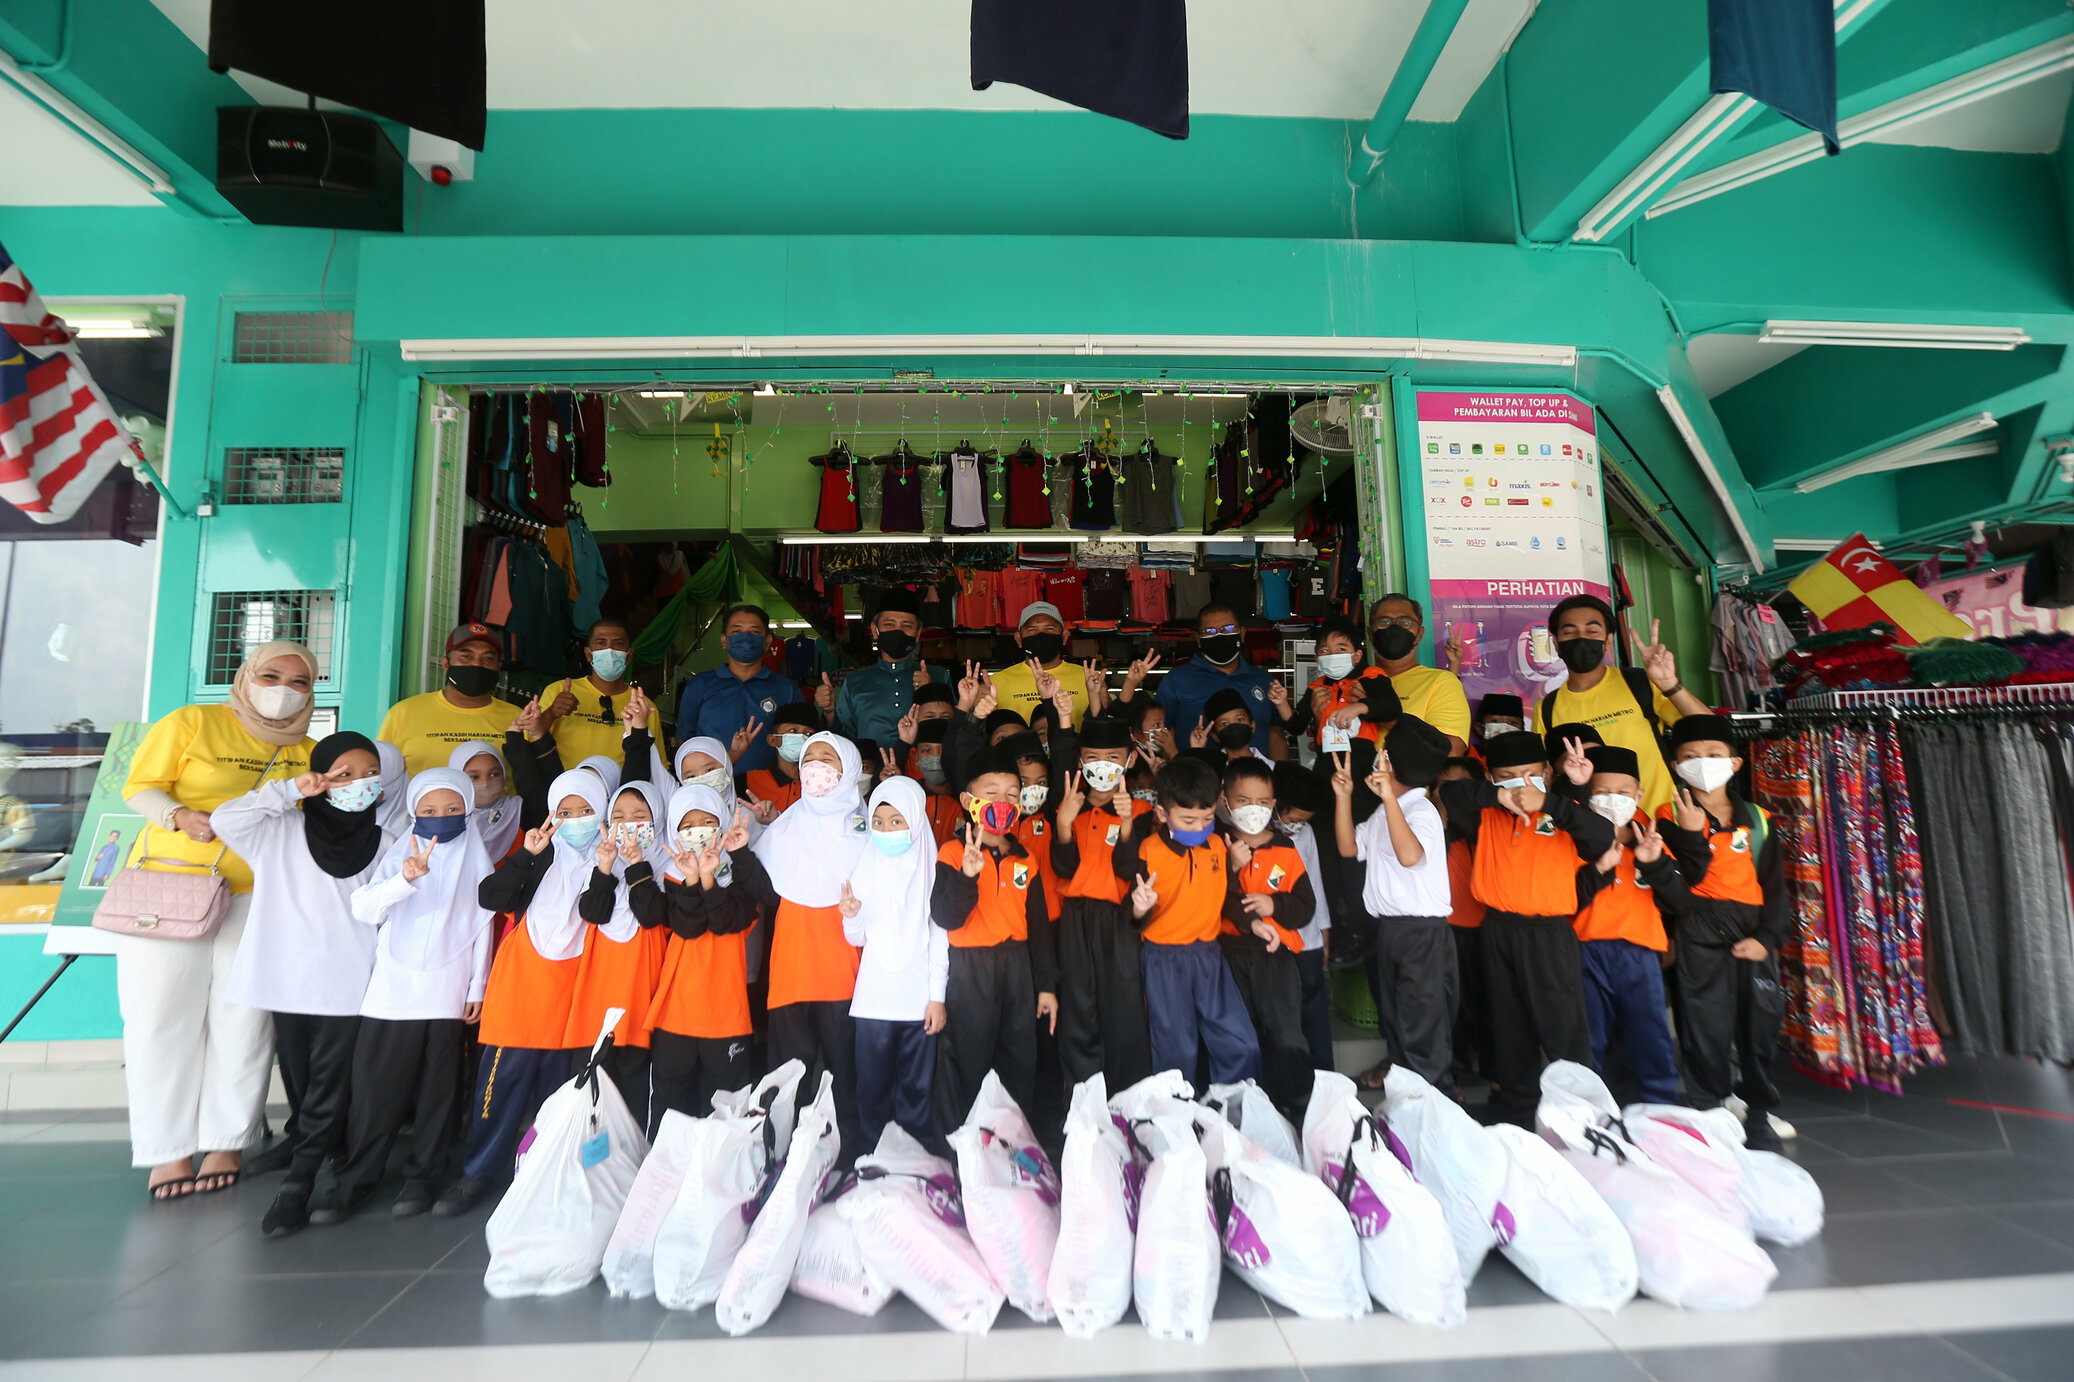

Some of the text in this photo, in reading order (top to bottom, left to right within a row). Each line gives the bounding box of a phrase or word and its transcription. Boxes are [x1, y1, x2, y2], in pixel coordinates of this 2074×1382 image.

[1470, 397, 1568, 407] WALLET PAY, TOP UP &
[1454, 408, 1518, 417] PEMBAYARAN
[1521, 409, 1533, 418] BIL
[1535, 409, 1556, 418] ADA
[1558, 409, 1568, 418] DI
[1509, 480, 1531, 489] maxis
[1465, 538, 1486, 546] astro
[1311, 578, 1325, 595] E
[1487, 581, 1584, 596] PERHATIAN
[1613, 708, 1634, 717] METRO
